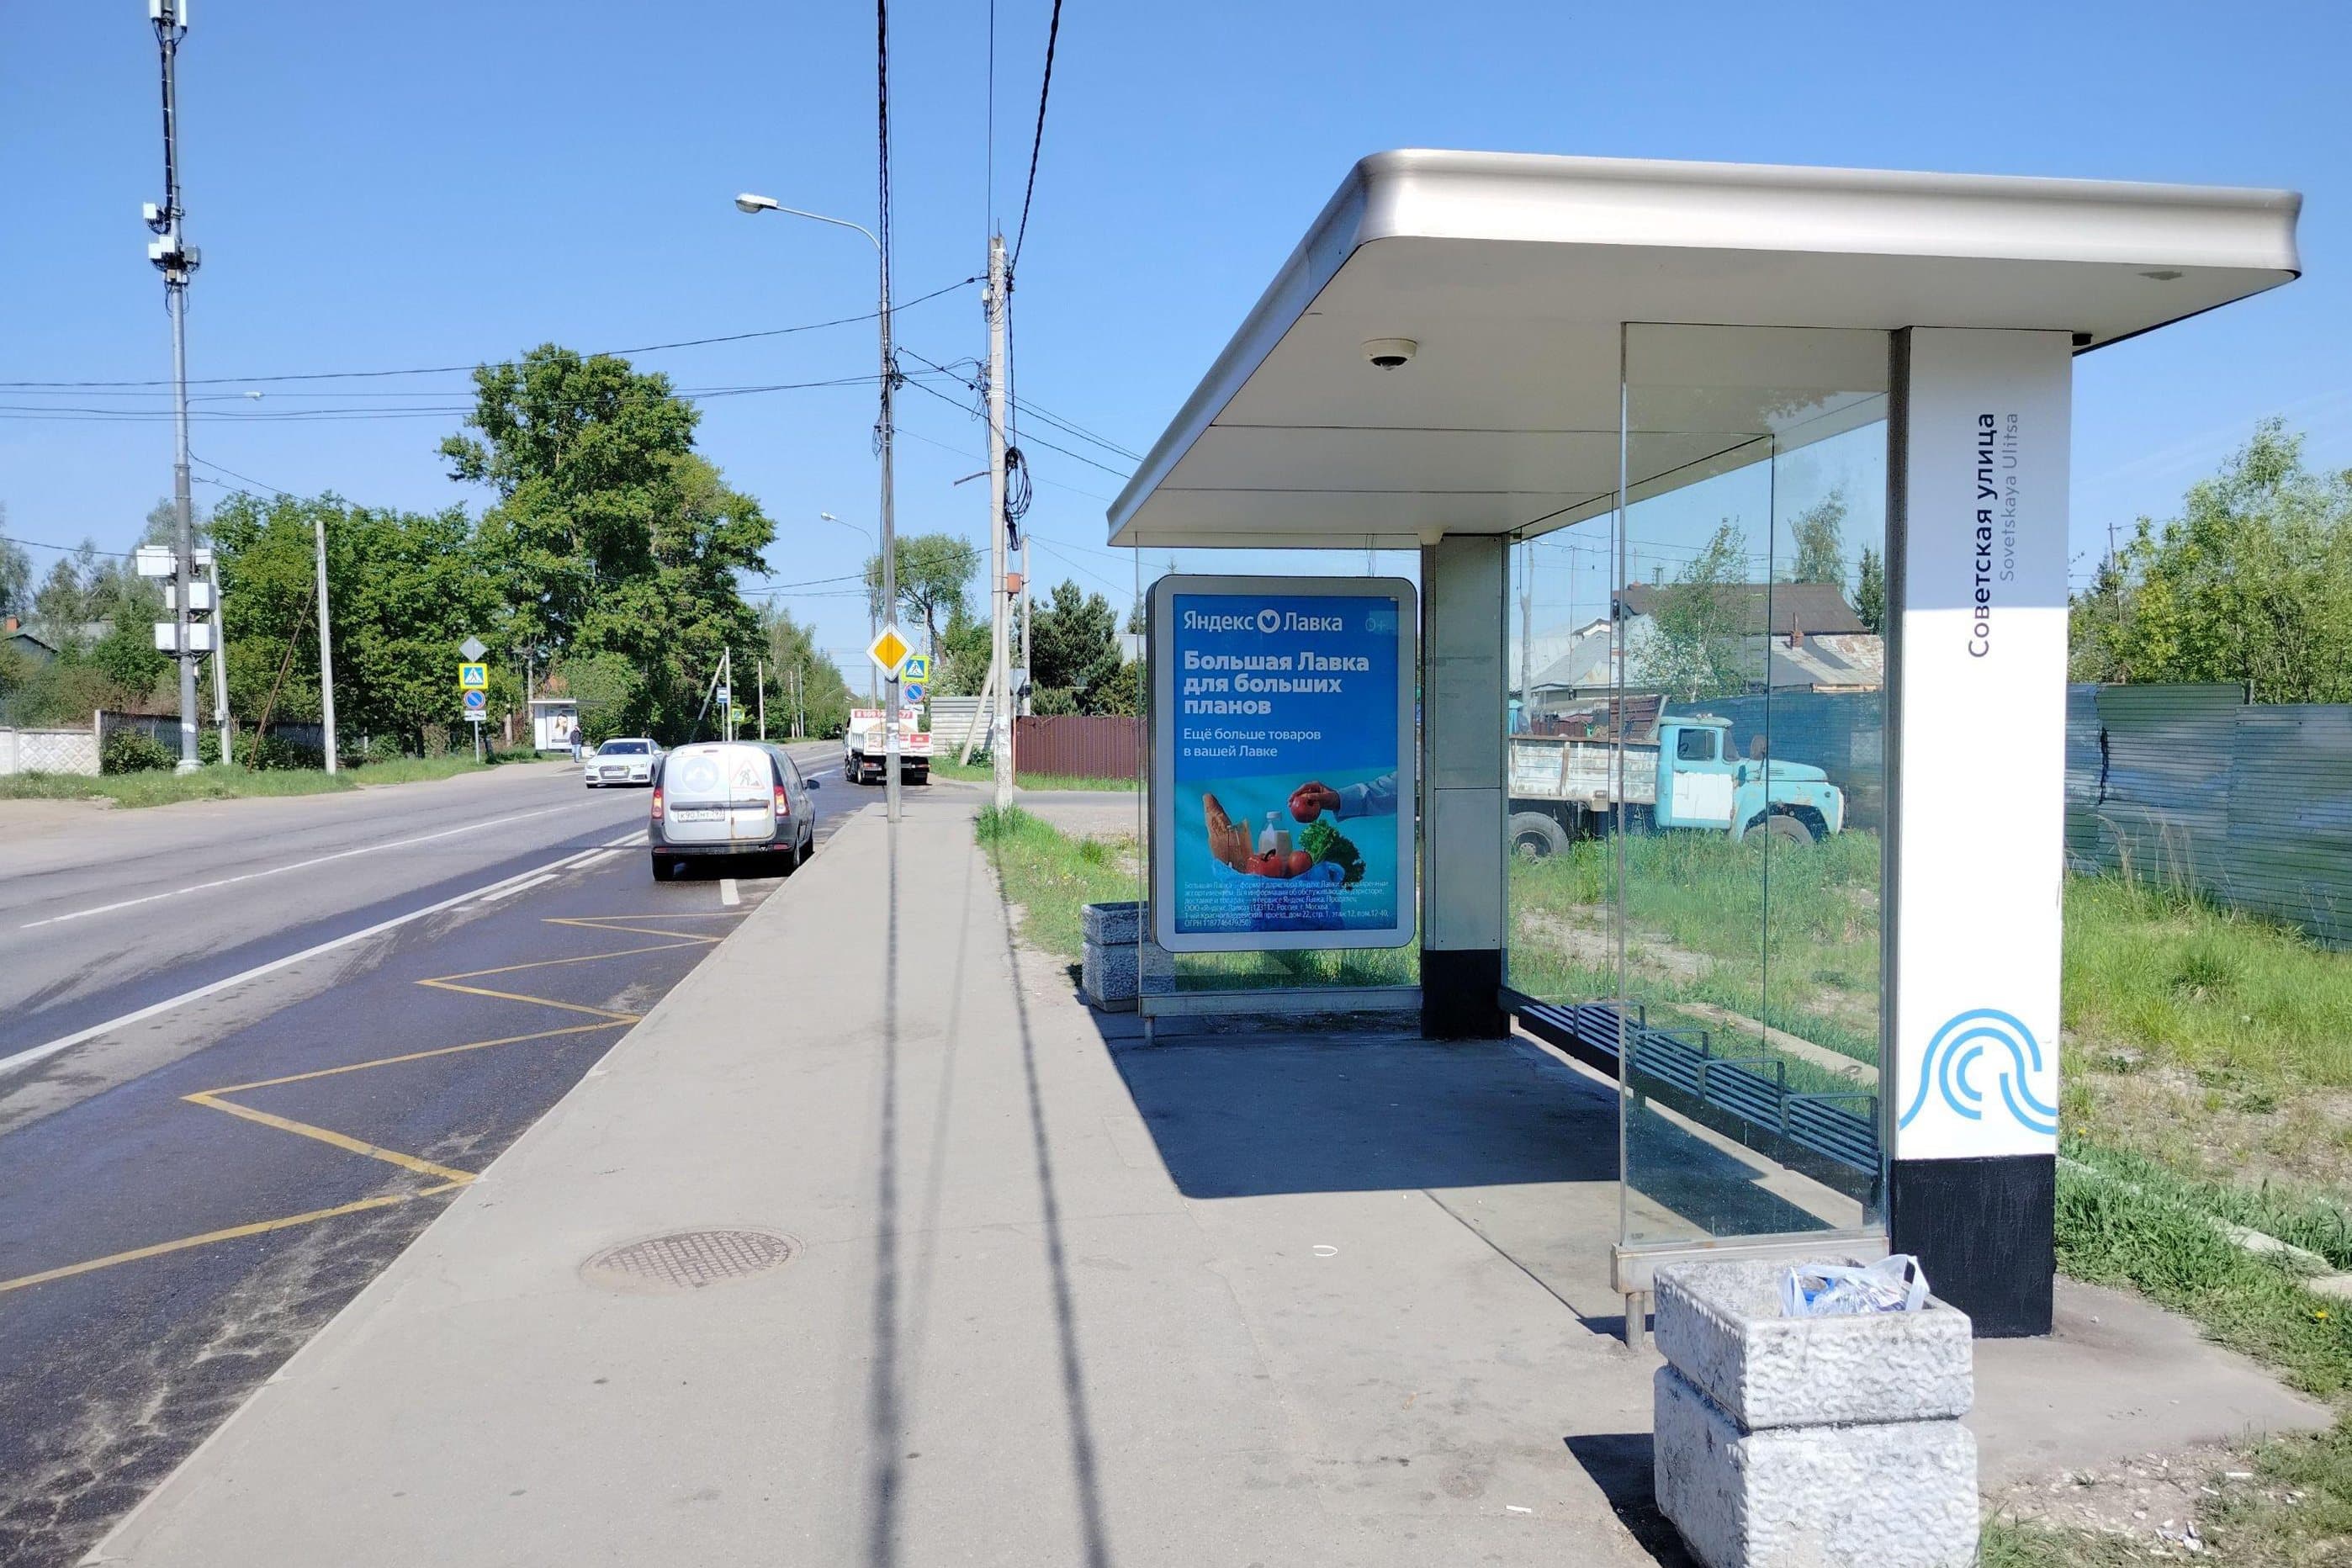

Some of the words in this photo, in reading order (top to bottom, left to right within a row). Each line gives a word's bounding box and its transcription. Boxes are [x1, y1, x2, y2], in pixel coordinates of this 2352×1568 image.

[2002, 413, 2018, 469] Ulitsa
[1977, 413, 1998, 501] улица
[2000, 474, 2020, 581] Sovetskaya
[1968, 509, 1993, 658] Советская
[1184, 610, 1253, 632] Яндекс
[1283, 612, 1343, 632] Лавка
[1365, 617, 1386, 632] 0+
[1184, 650, 1292, 671] Большая
[1297, 652, 1369, 671] Лавка
[1184, 677, 1229, 696] для
[1234, 673, 1343, 693] больших
[1184, 700, 1272, 715] планов
[1184, 728, 1212, 742] Ещё
[1215, 728, 1266, 740] больше
[1269, 729, 1322, 743] товаров
[1184, 745, 1192, 757] в
[1194, 744, 1237, 757] вашей
[1239, 745, 1278, 757] Лавке
